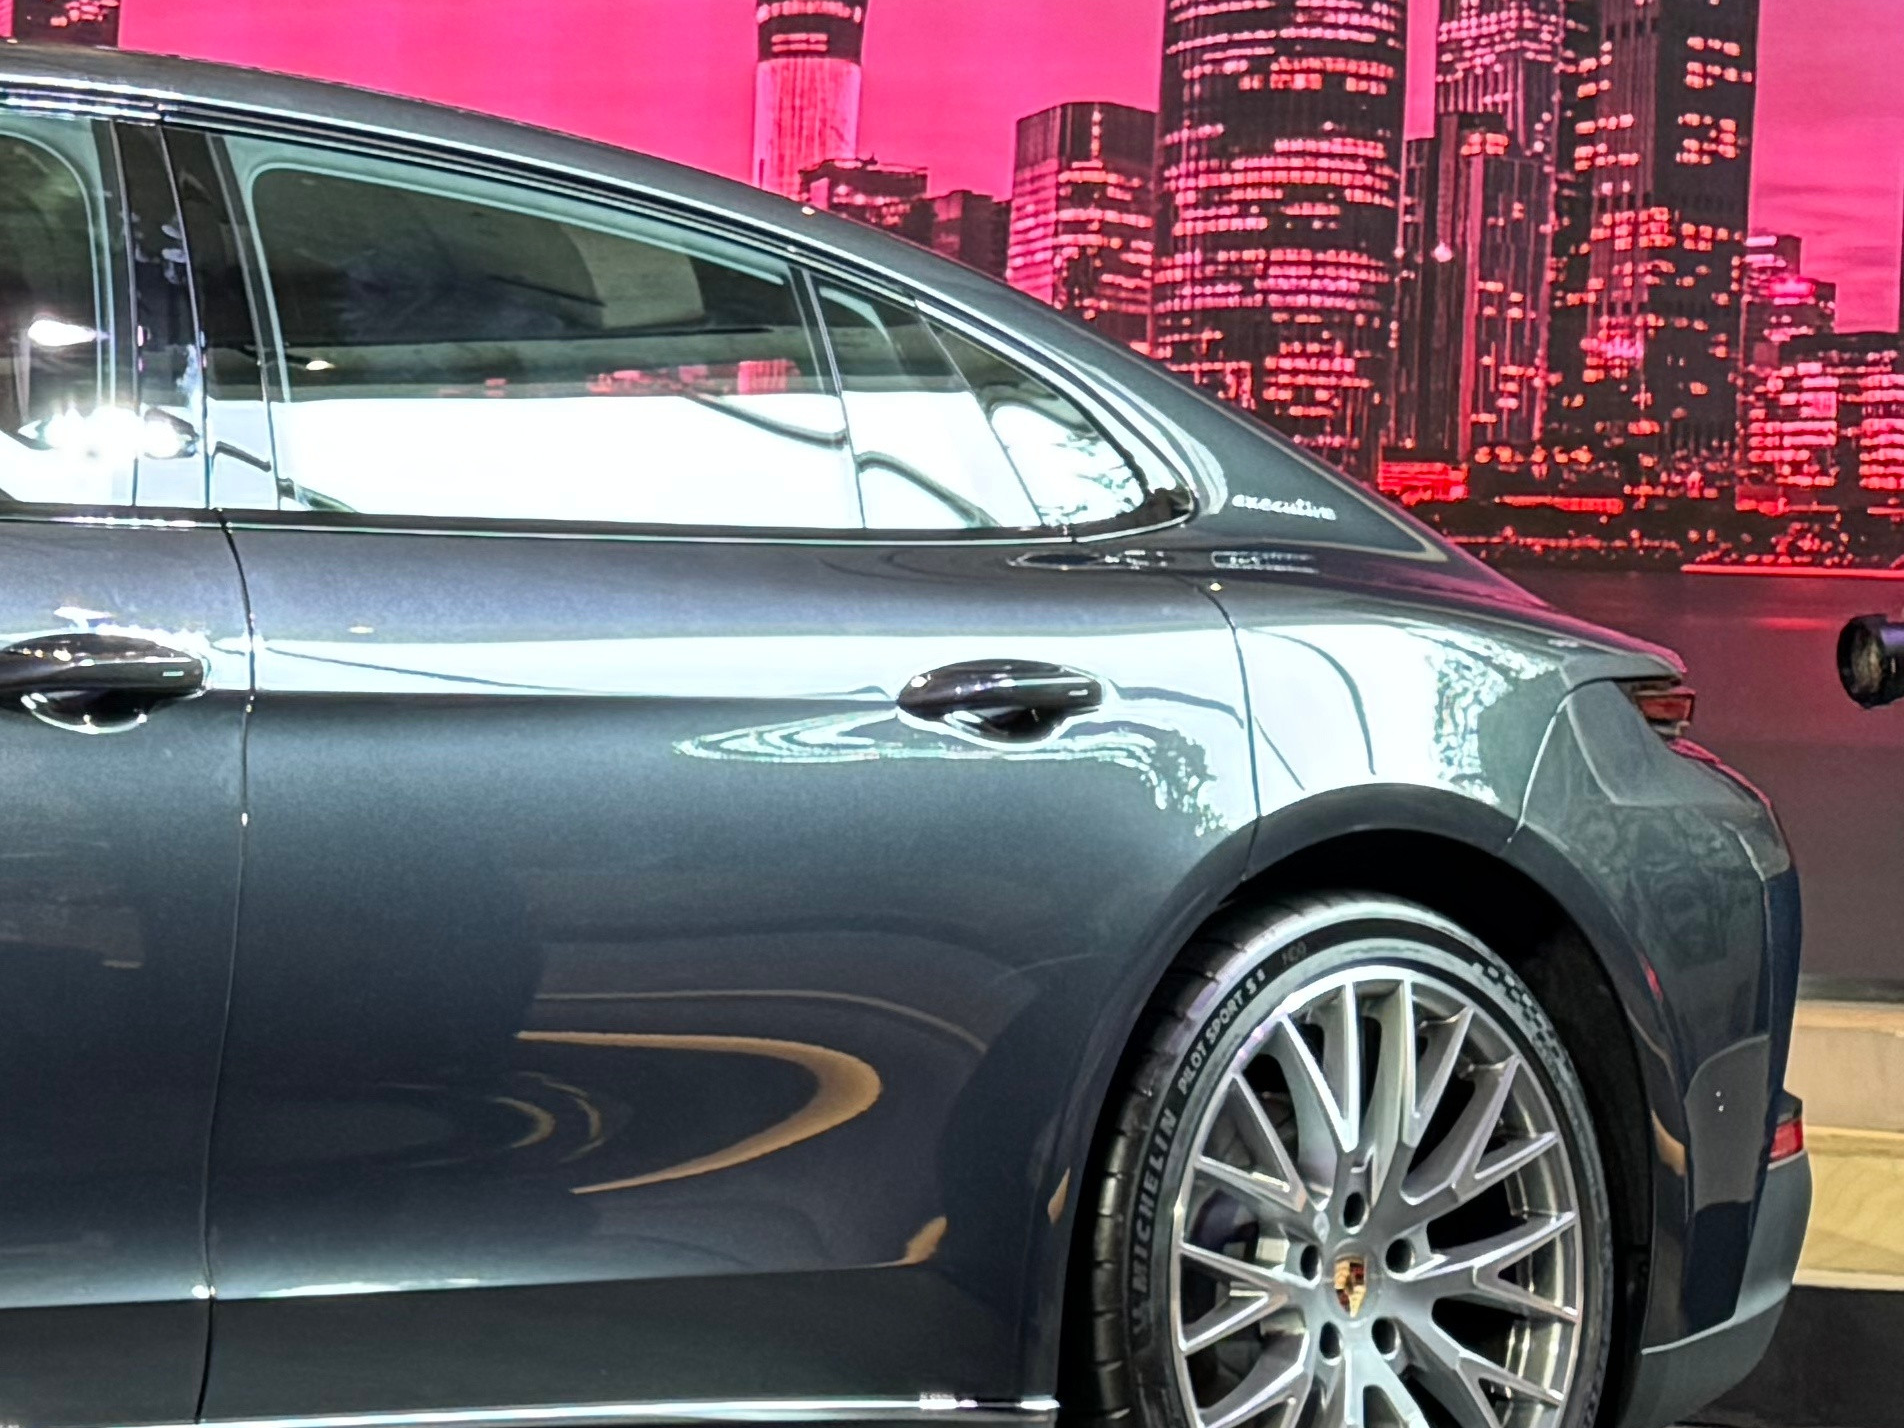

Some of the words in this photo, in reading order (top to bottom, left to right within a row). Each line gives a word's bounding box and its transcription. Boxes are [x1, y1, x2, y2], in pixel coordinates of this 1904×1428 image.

[1131, 1108, 1178, 1294] MICHELIN
[1177, 1045, 1206, 1096] PILOT
[1205, 993, 1244, 1050] SPORT
